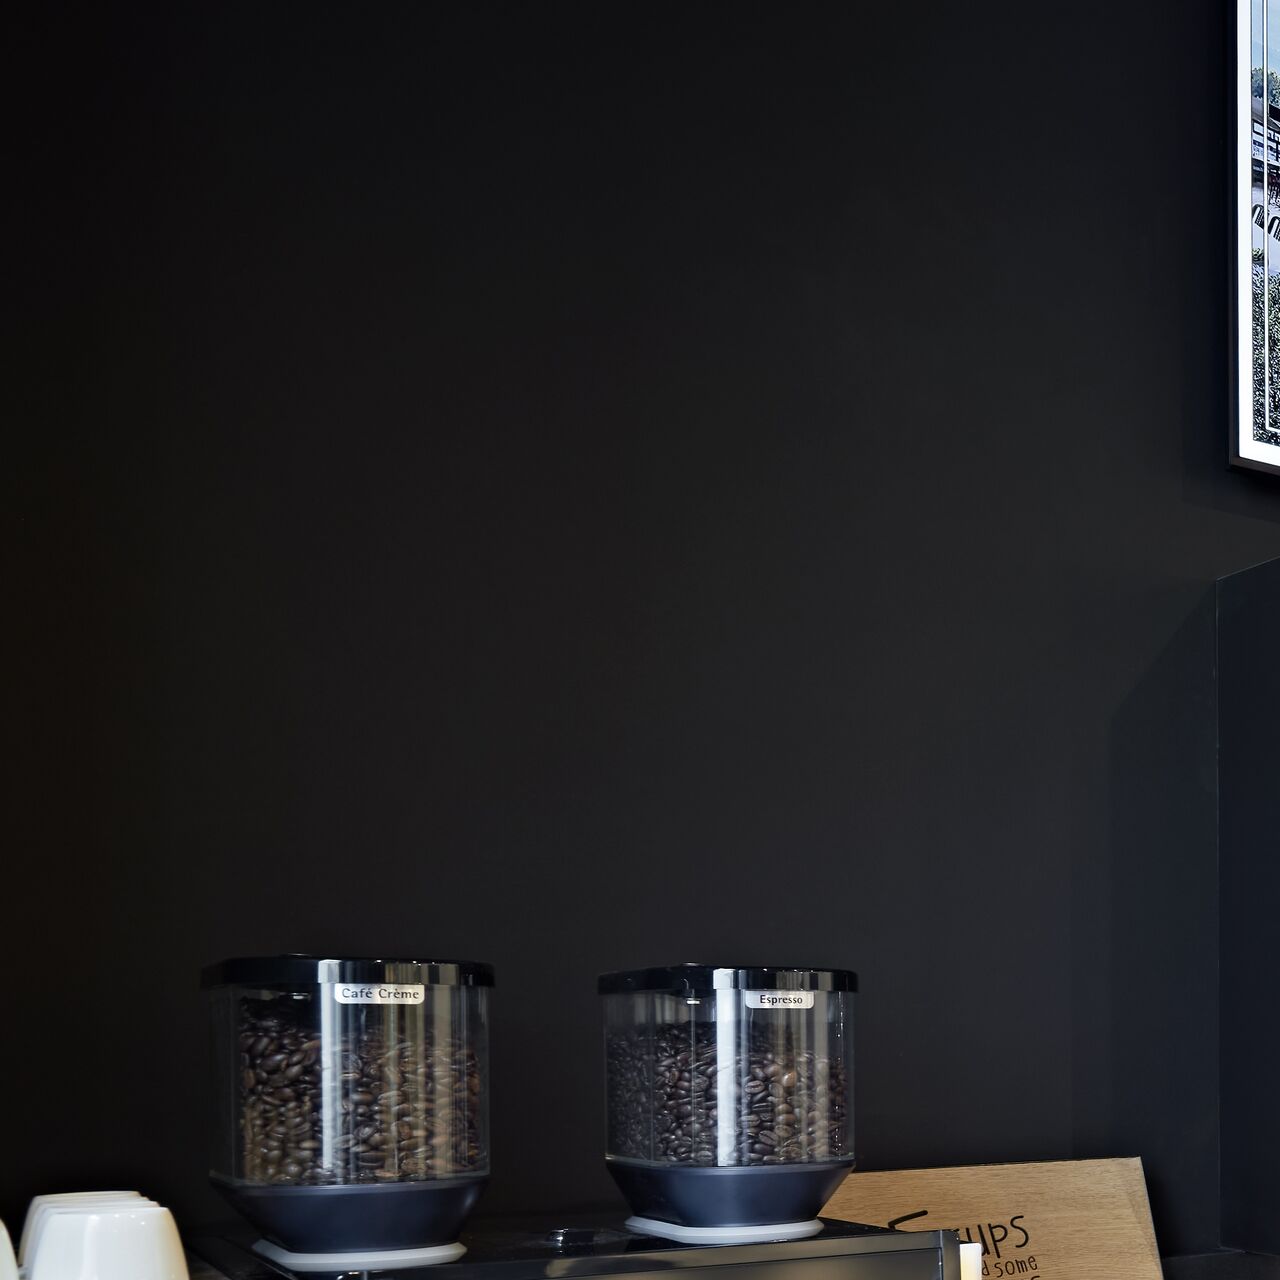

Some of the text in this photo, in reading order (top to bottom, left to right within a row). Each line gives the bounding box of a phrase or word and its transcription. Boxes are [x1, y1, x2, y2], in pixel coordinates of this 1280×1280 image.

[342, 988, 420, 999] Café Crème
[760, 995, 803, 1006] Espresso
[955, 1215, 1030, 1259] UPS
[994, 1256, 1038, 1278] some
